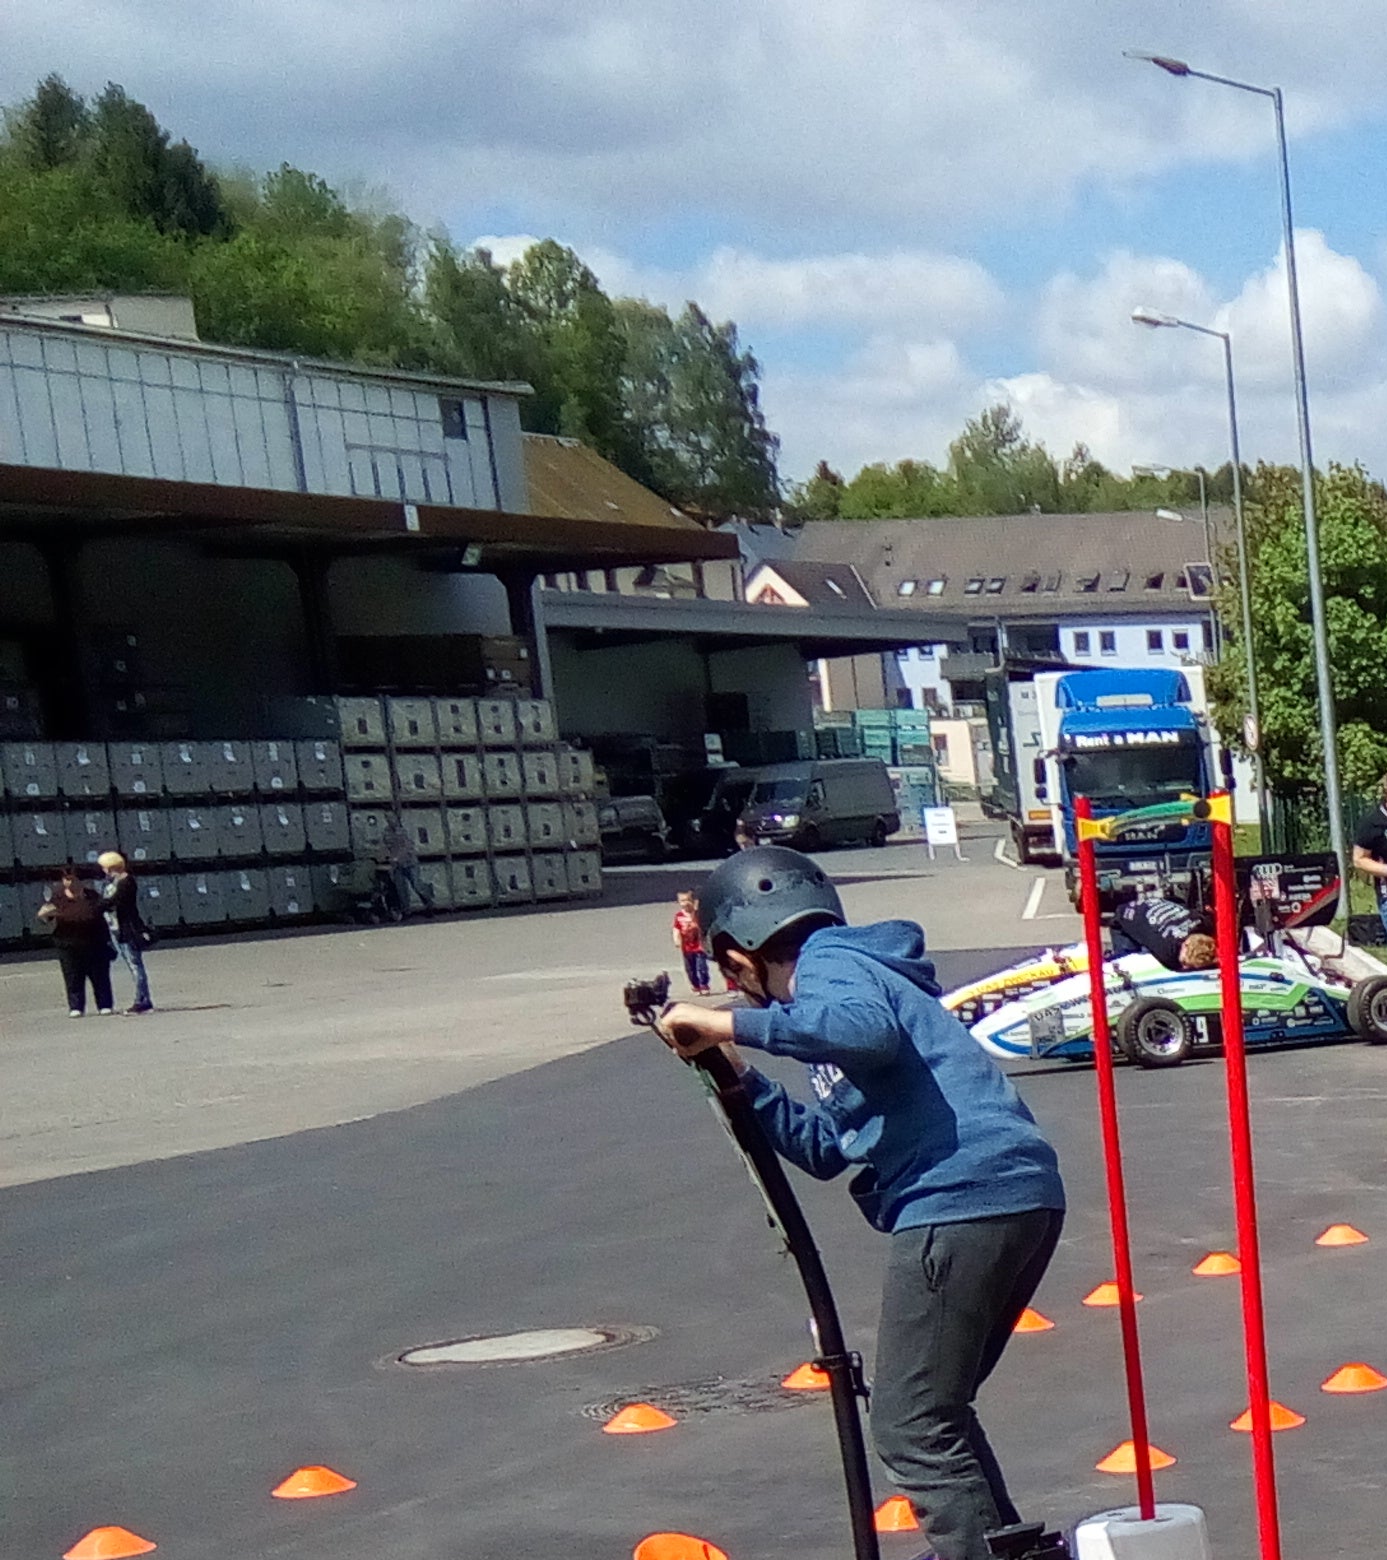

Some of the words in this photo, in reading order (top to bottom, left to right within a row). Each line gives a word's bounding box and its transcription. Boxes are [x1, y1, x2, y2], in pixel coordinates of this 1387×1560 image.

[1075, 733, 1110, 748] Rent
[1113, 734, 1123, 745] a
[1126, 731, 1180, 744] MAN
[1124, 831, 1158, 841] MAN
